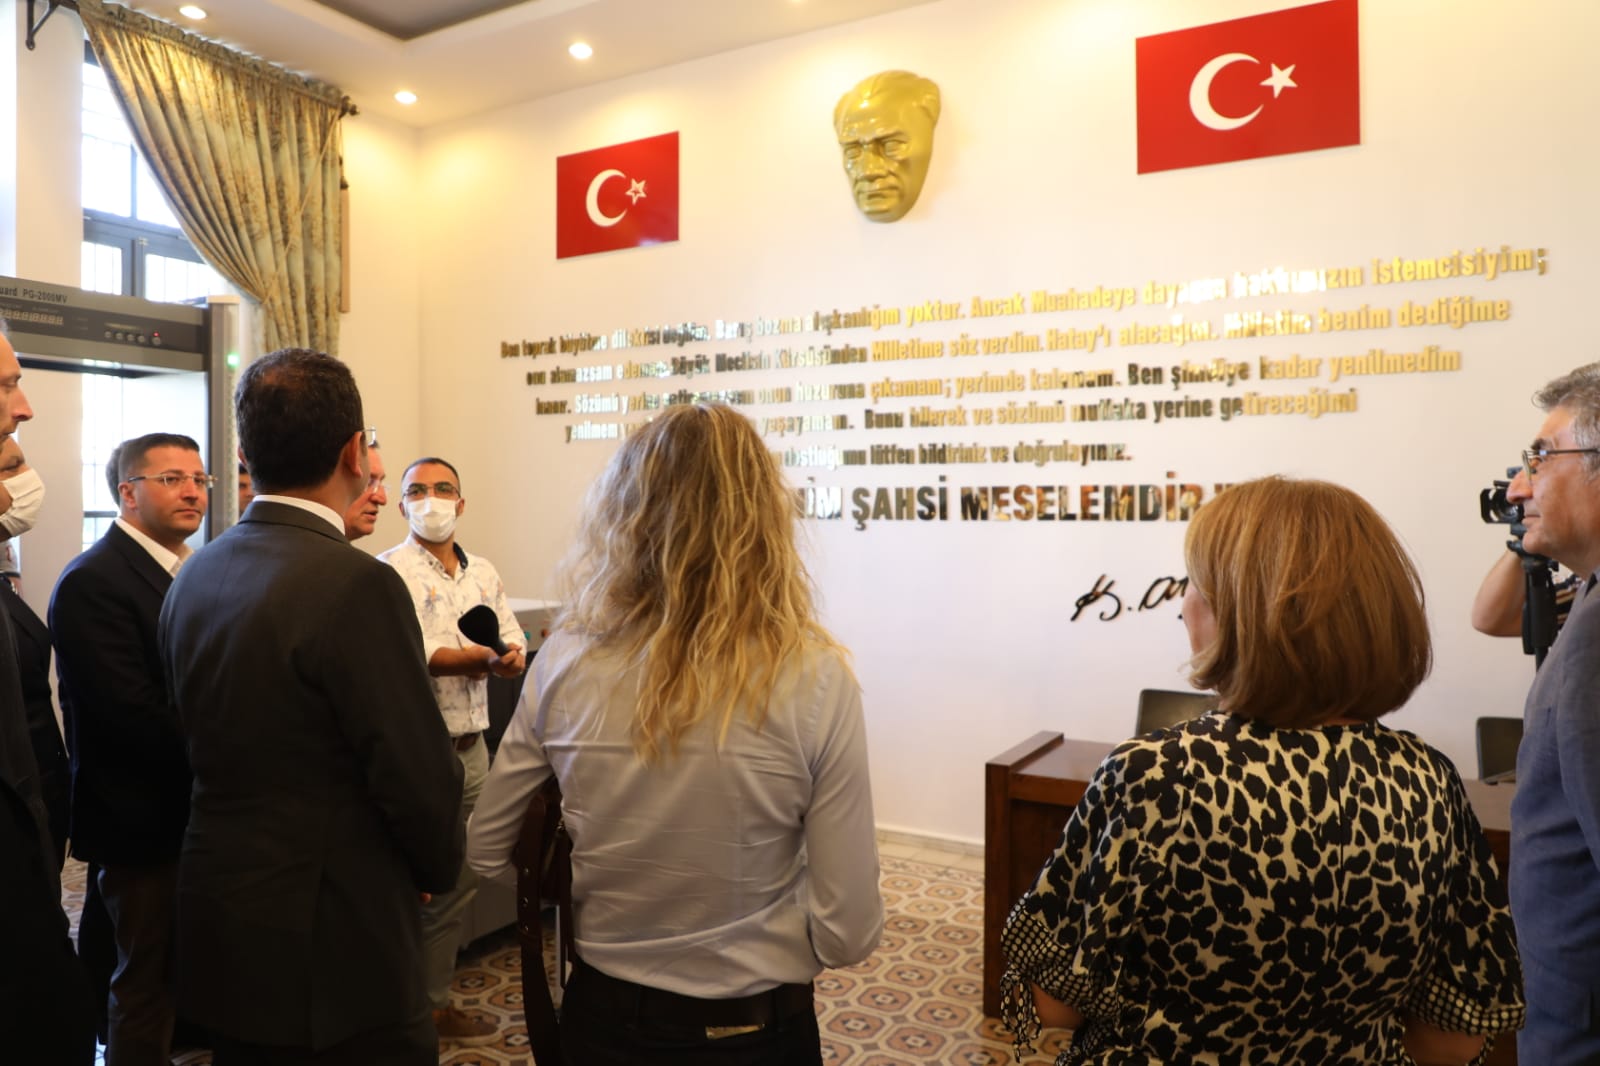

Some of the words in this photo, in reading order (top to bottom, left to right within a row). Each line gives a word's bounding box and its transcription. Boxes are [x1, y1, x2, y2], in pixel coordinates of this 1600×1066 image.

[0, 287, 18, 297] uard
[905, 299, 965, 328] yoktur.
[970, 292, 1025, 318] Ancak
[871, 338, 944, 362] Milletime
[950, 332, 978, 357] söz
[981, 331, 1043, 354] verdim.
[1046, 323, 1111, 353] Hatay'ı
[1119, 313, 1218, 346] alacağım.
[1224, 309, 1312, 340] Milletim
[1318, 303, 1391, 332] benim
[1397, 295, 1511, 329] dediğime
[955, 370, 1025, 399] yerimde
[1030, 367, 1121, 391] kalamam.
[1127, 362, 1163, 386] Ben
[1171, 357, 1250, 391] şimdiye
[1260, 353, 1322, 380] kadar
[1328, 345, 1462, 382] yenilmedim
[864, 409, 903, 429] Bunu
[910, 404, 967, 428] bilerek
[972, 408, 994, 426] ve
[997, 399, 1066, 424] sözümü
[1071, 398, 1147, 422] mutlaka
[1153, 395, 1212, 424] yerine
[1220, 387, 1358, 422] getireceğimi
[870, 443, 915, 465] lütfen
[918, 442, 987, 465] bildiriniz
[990, 444, 1009, 463] ve
[851, 475, 949, 531] ŞAHSİ
[960, 471, 1204, 521] MESELEMDİR
